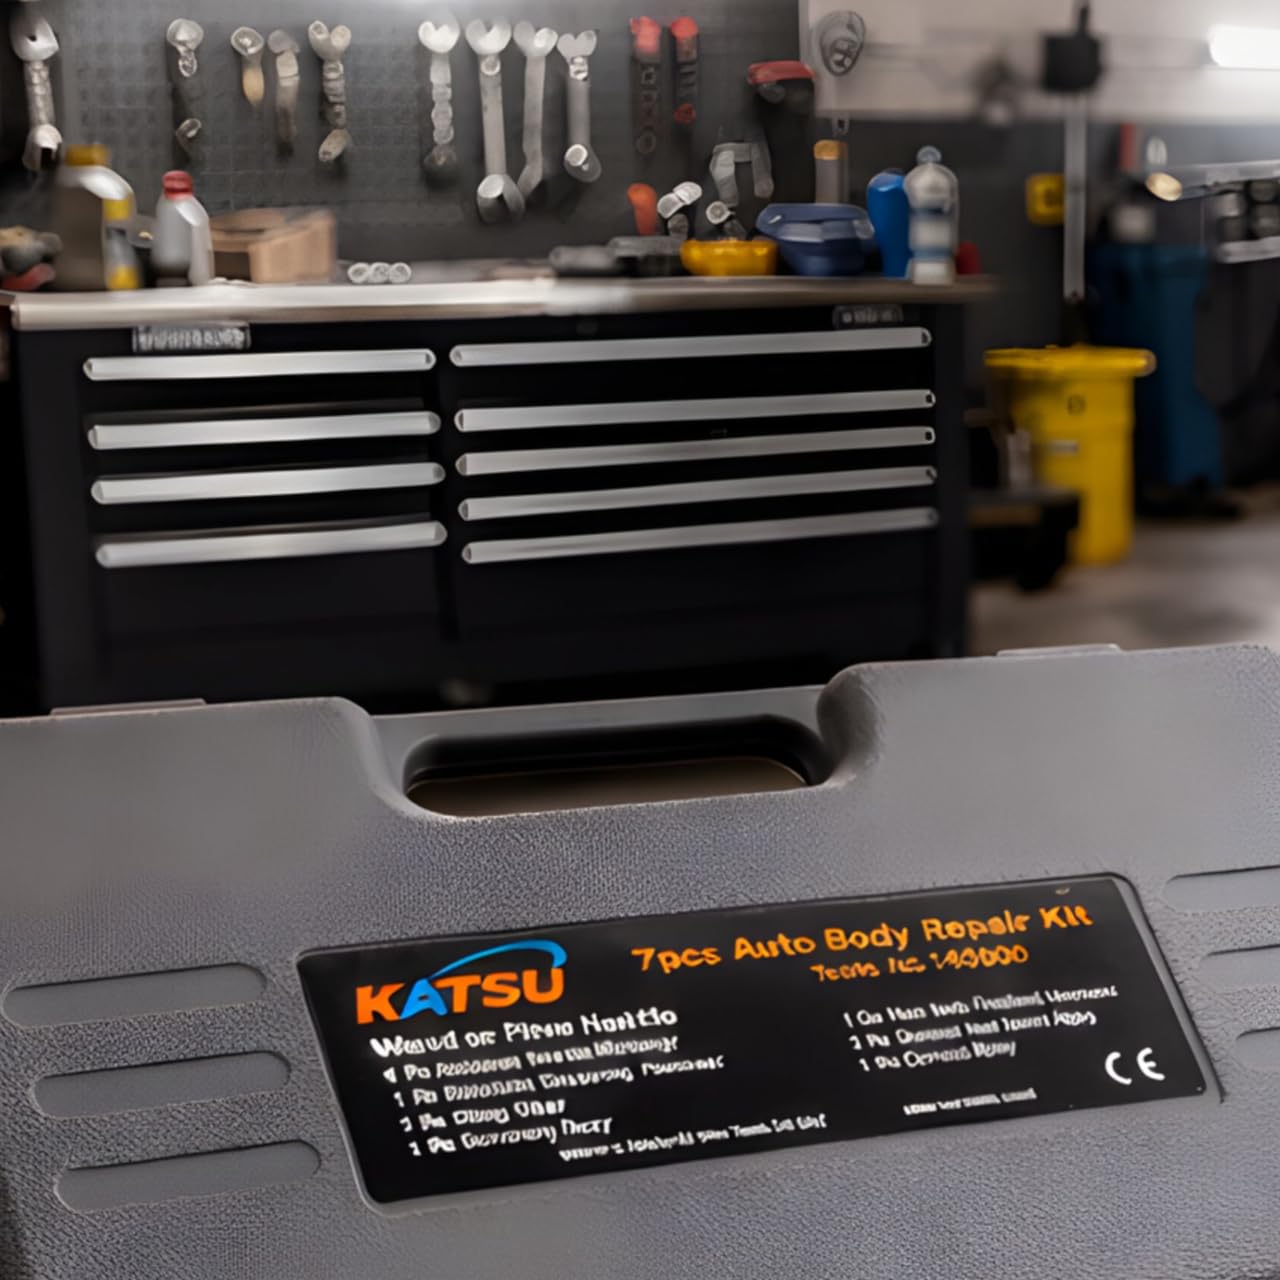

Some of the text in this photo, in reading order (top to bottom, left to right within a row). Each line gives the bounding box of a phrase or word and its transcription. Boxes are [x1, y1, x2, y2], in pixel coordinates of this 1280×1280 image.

[632, 947, 721, 973] 7pcs
[734, 933, 816, 960] Auto
[824, 923, 908, 951] Body
[356, 967, 566, 1026] KATSU
